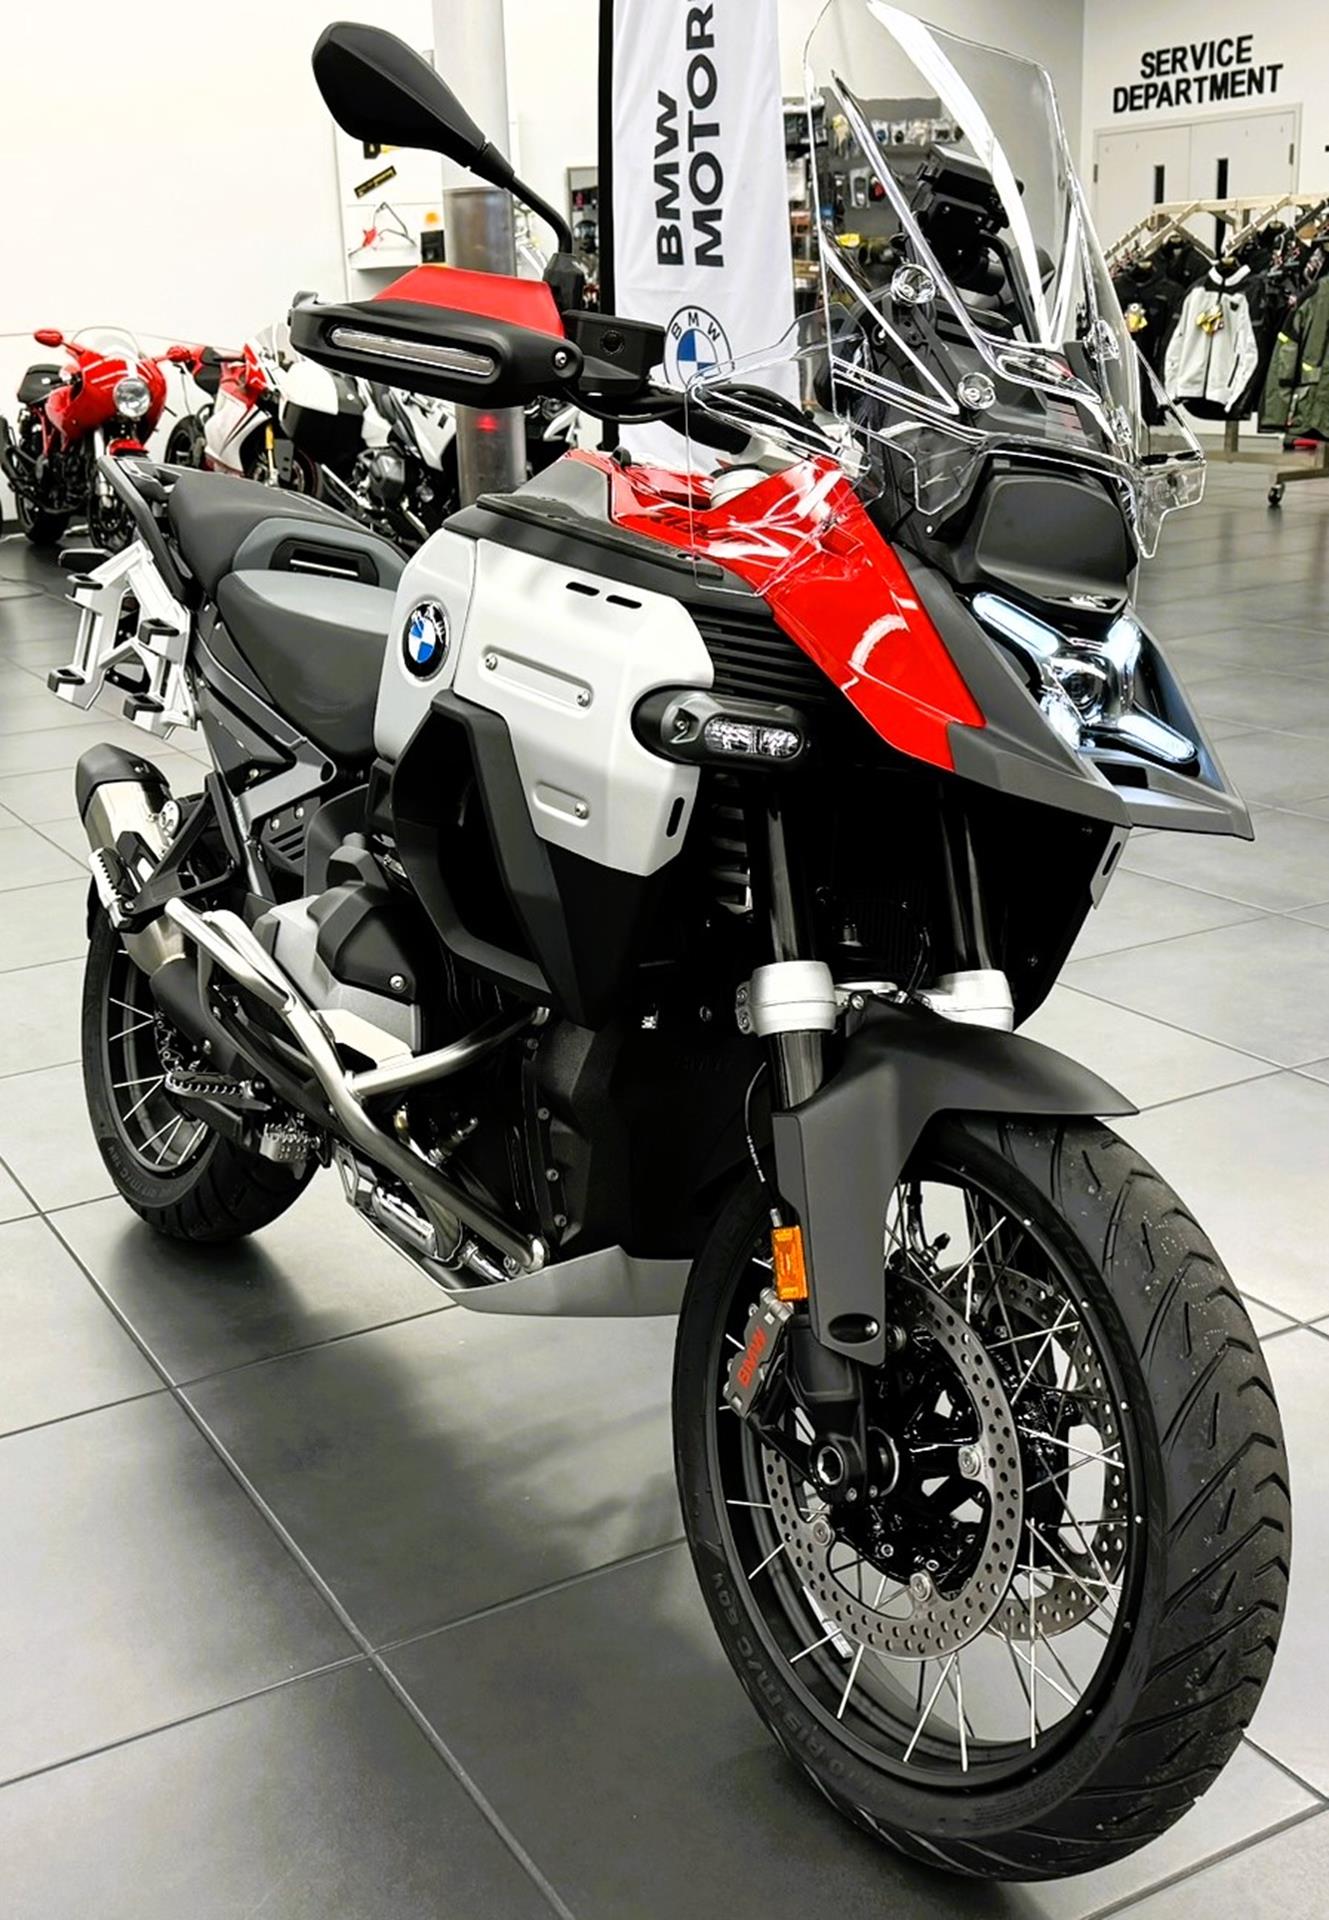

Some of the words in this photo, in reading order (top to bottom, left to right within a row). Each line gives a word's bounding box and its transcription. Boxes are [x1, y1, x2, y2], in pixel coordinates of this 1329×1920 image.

[1140, 34, 1253, 79] SERVICE
[1113, 64, 1284, 114] DEPARTMENT
[686, 0, 724, 267] MOTOR
[654, 90, 684, 265] BMW
[671, 311, 720, 341] BMW
[737, 1326, 768, 1388] BMW
